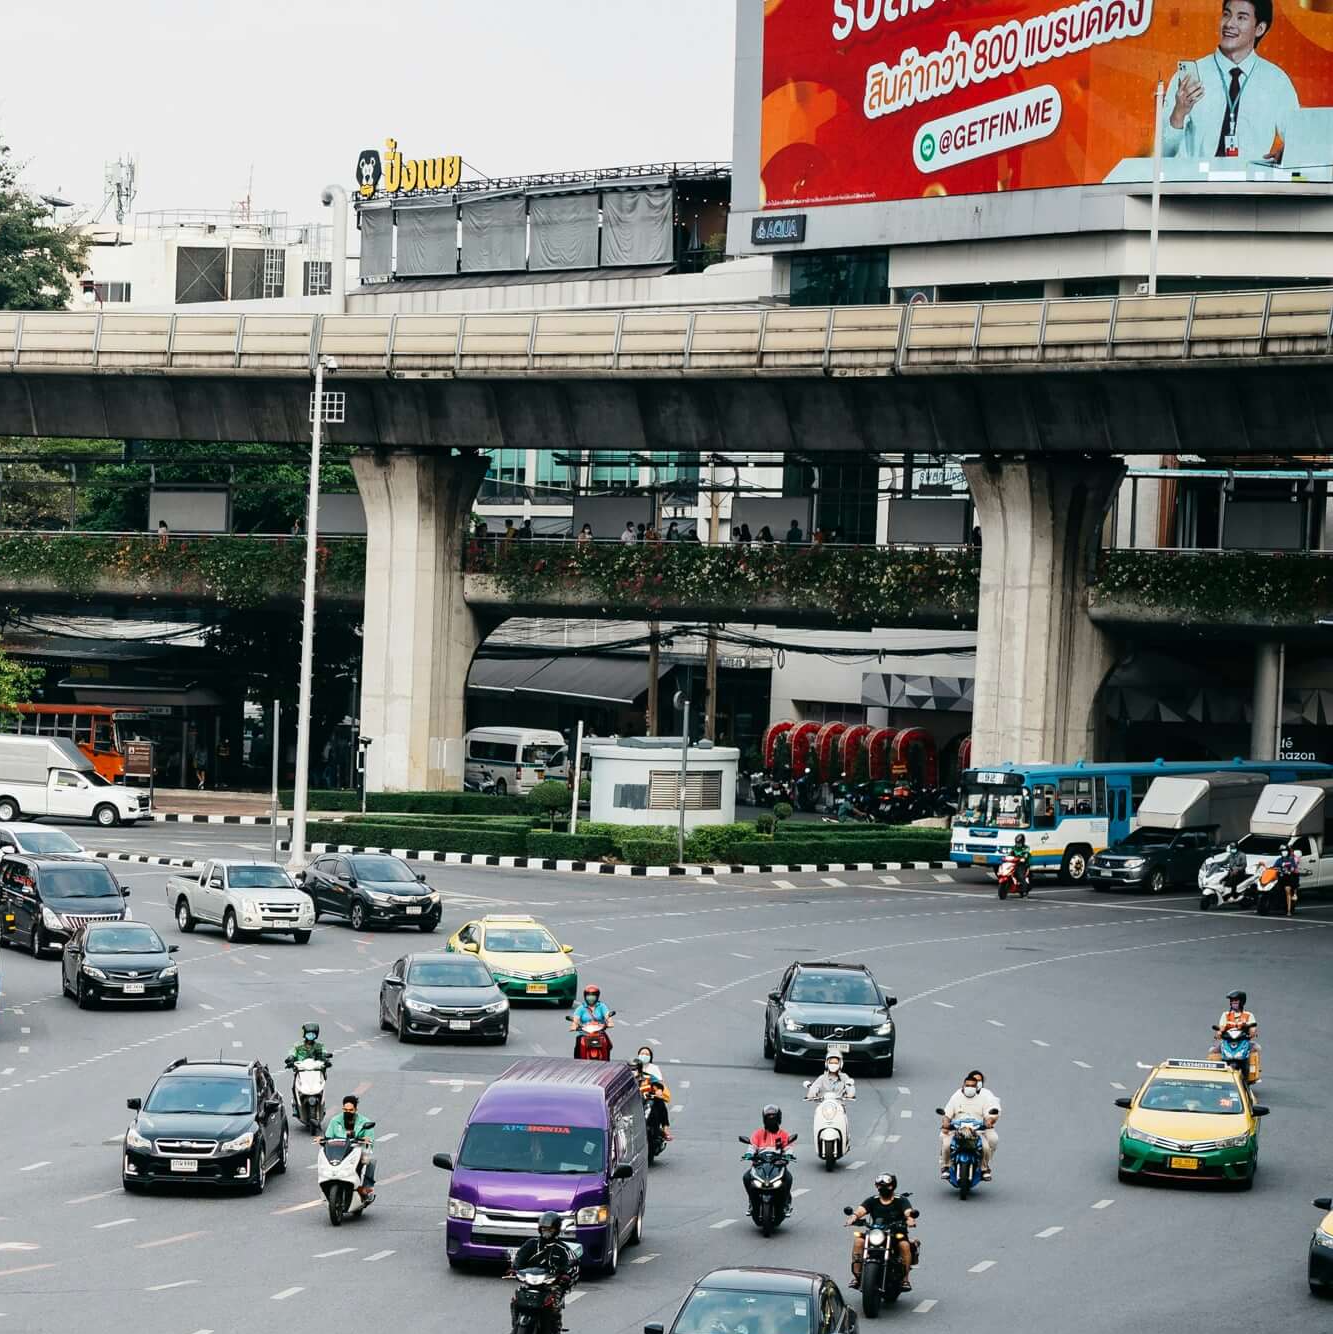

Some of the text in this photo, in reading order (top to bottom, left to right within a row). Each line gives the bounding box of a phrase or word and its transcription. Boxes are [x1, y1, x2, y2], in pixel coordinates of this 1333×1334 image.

[868, 0, 1146, 110] สินค้ากว่า 800 แบรนดดง
[939, 97, 1054, 155] @GETFIN.ME
[766, 219, 798, 239] AQUA
